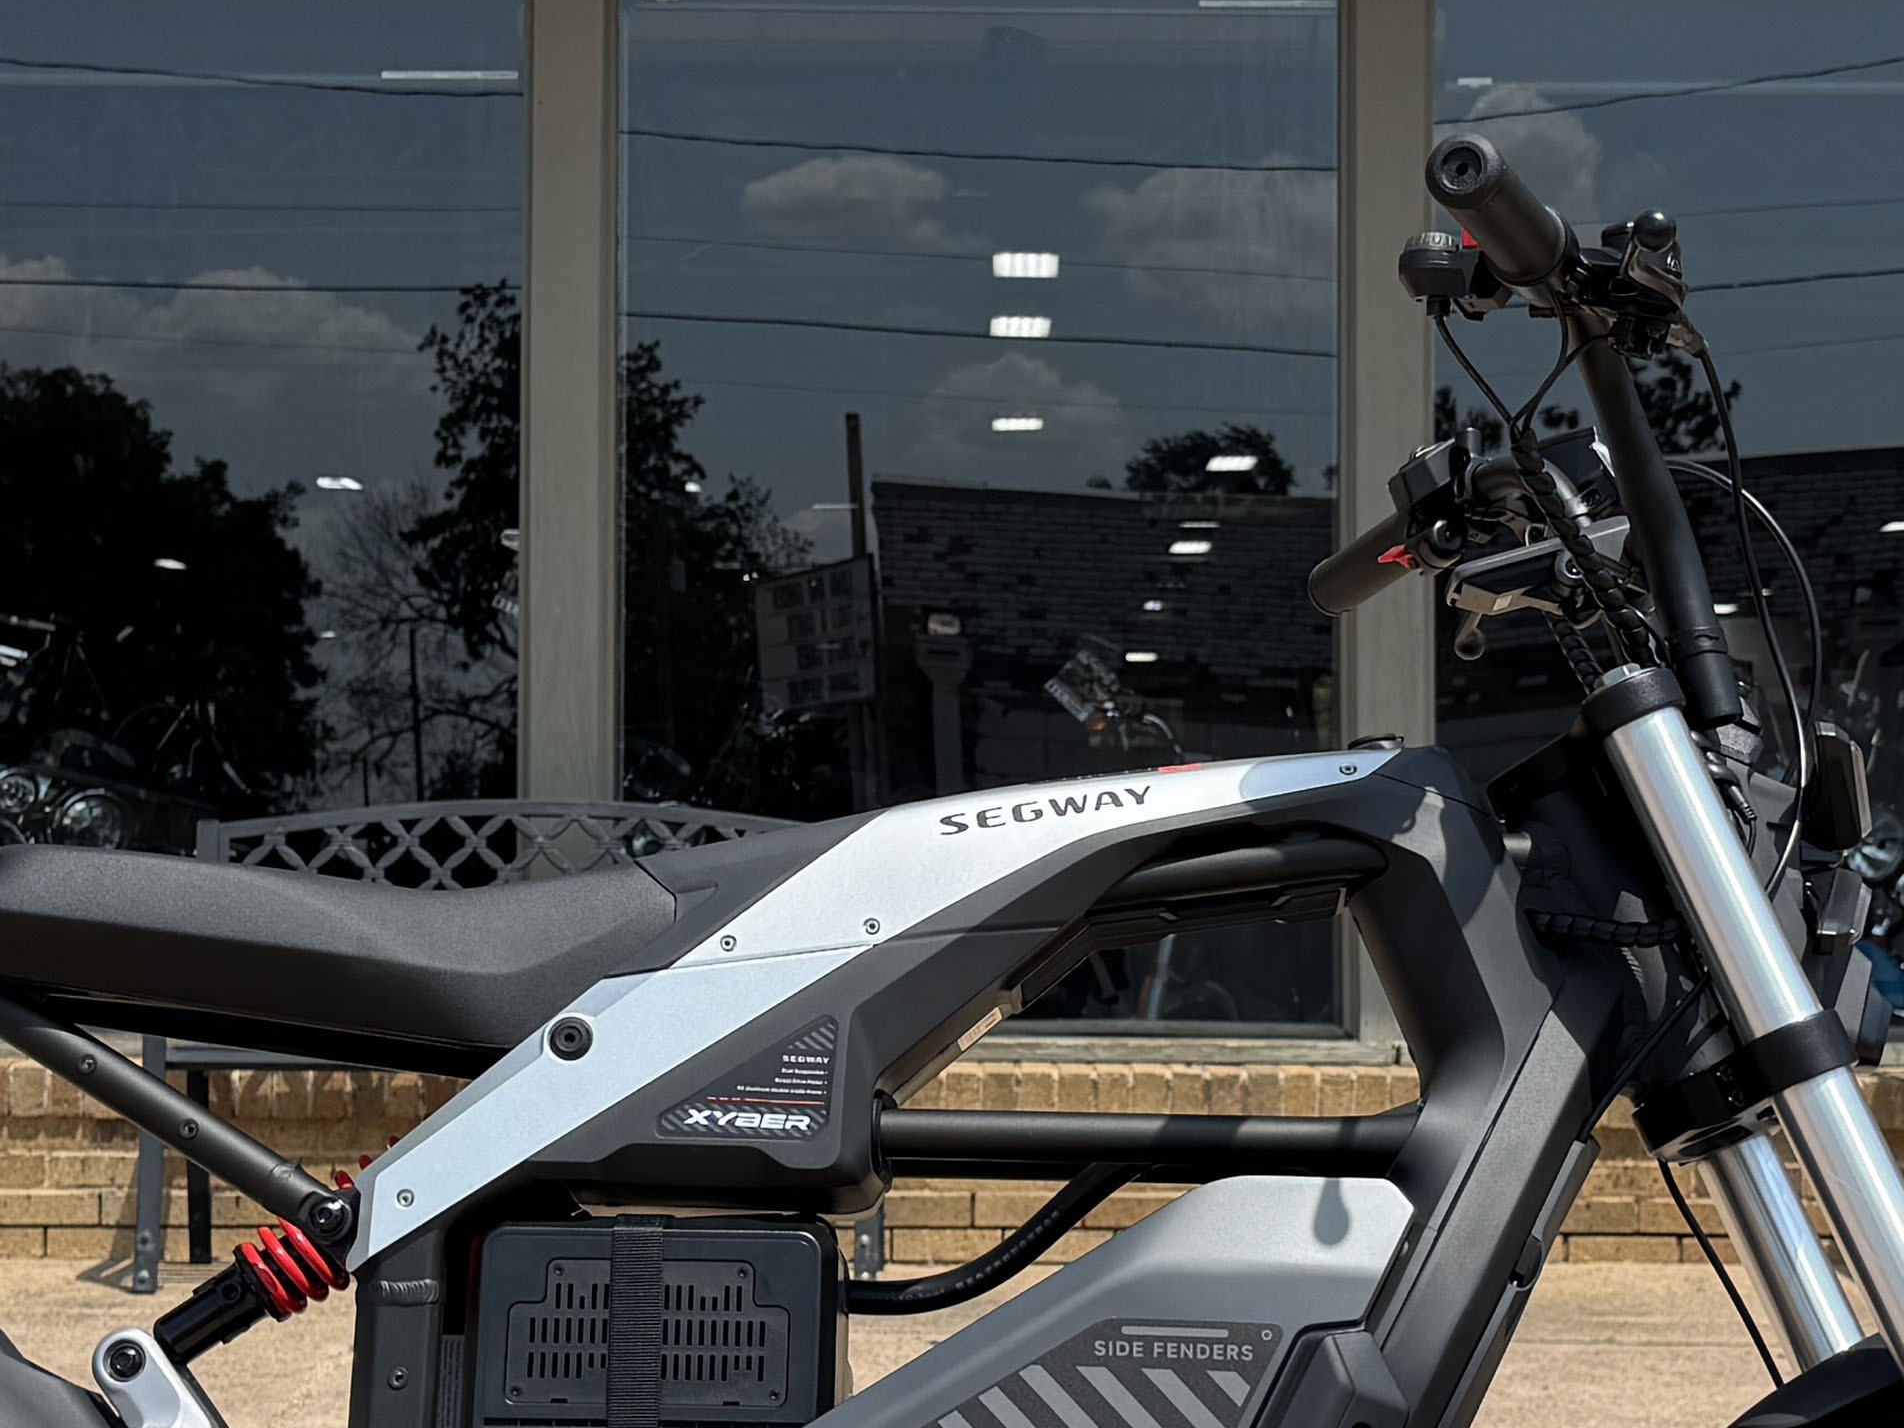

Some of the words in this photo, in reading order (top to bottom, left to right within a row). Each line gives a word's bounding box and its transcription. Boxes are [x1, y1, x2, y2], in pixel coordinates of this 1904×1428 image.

[938, 784, 1151, 836] SEGWAY
[781, 1054, 830, 1065] SEGWAY
[683, 1108, 812, 1132] XYBER
[1093, 1339, 1145, 1358] SIDE
[1152, 1341, 1255, 1362] FENDERS
